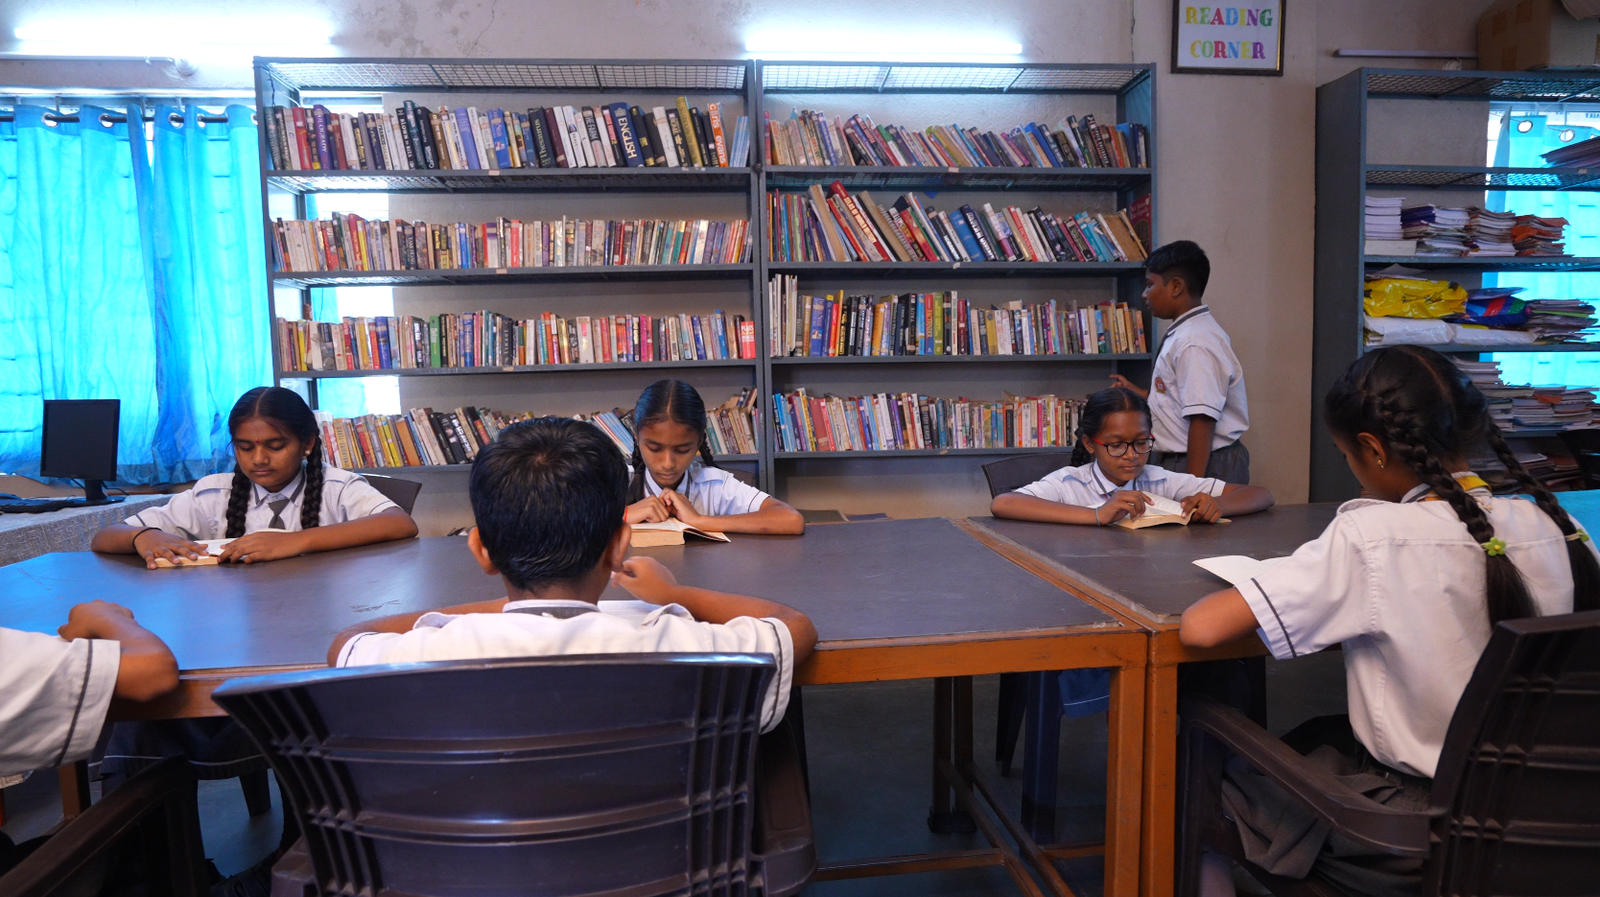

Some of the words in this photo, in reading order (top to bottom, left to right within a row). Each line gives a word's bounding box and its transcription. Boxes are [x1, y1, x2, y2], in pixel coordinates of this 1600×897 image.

[1185, 6, 1273, 26] READING
[1190, 40, 1266, 59] CORNER
[532, 118, 547, 158] Thesaurus
[587, 123, 598, 139] FARM
[617, 116, 637, 159] ENGLISH
[715, 134, 726, 163] evans
[843, 195, 855, 210] ATLAS
[850, 207, 859, 216] OF
[854, 213, 867, 228] WORLD
[863, 226, 877, 244] HISTORY
